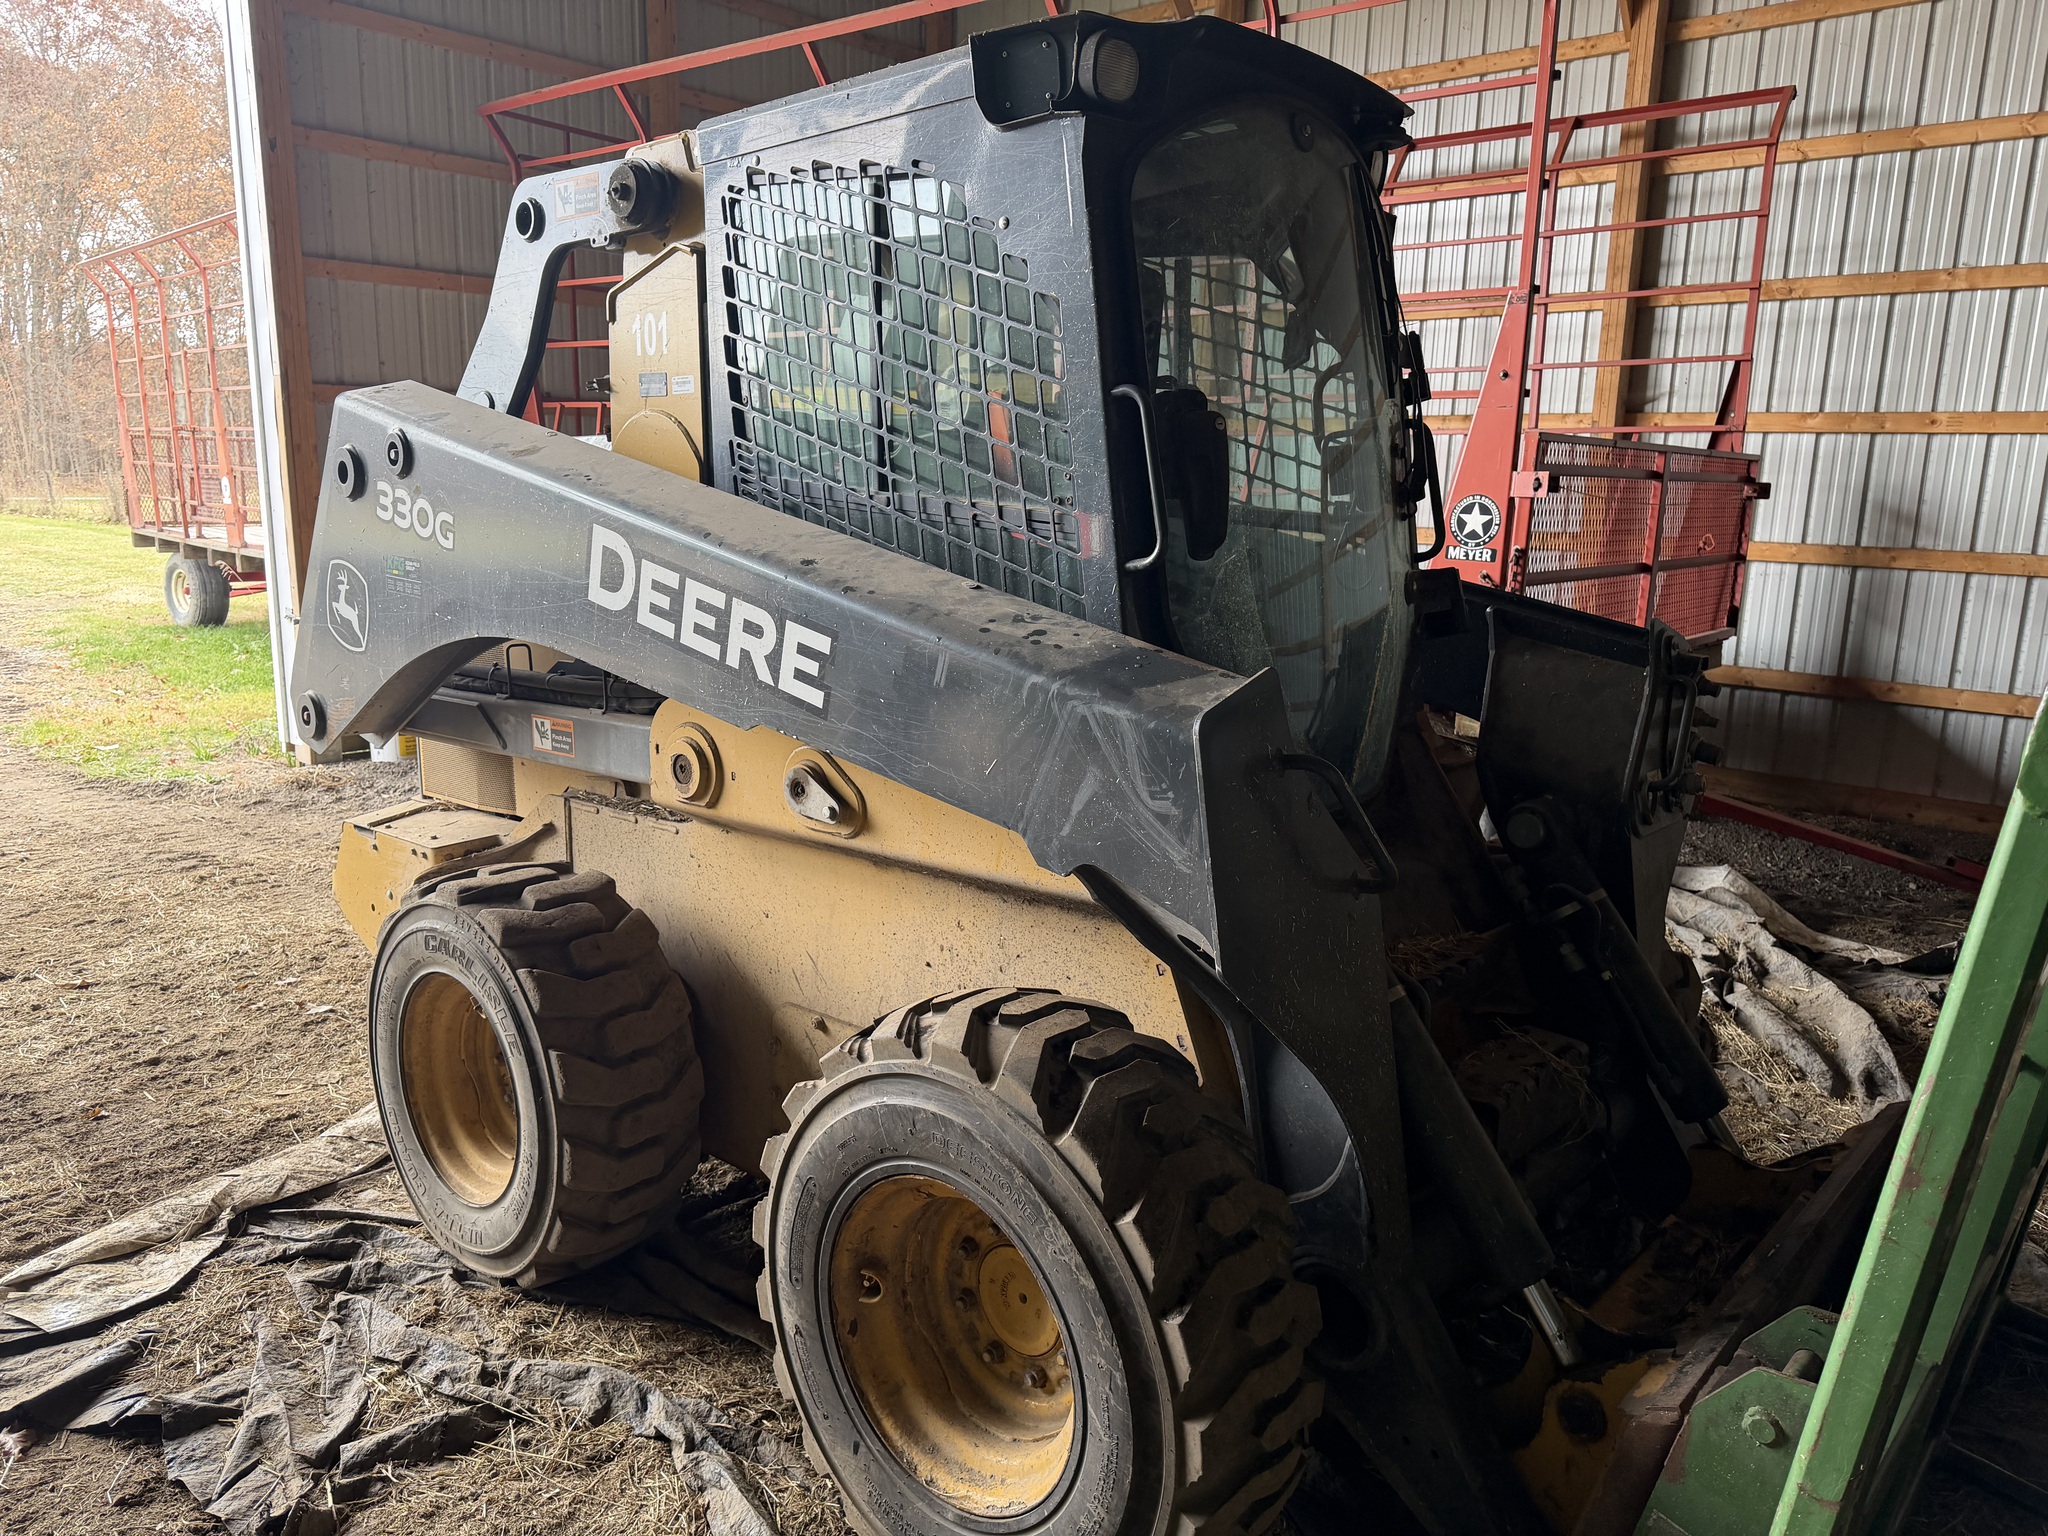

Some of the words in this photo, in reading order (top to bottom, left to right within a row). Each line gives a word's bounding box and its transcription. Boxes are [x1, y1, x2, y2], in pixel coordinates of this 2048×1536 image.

[632, 312, 668, 356] 101
[376, 482, 454, 549] 330G
[1447, 546, 1492, 562] MEYER
[587, 523, 832, 710] DEERE
[552, 733, 562, 741] Pinch
[563, 735, 572, 743] Area
[452, 914, 492, 954] SEVERE
[493, 954, 518, 994] DUTY
[424, 934, 522, 1058] CARLISLE
[932, 1131, 1038, 1225] DEESTONE
